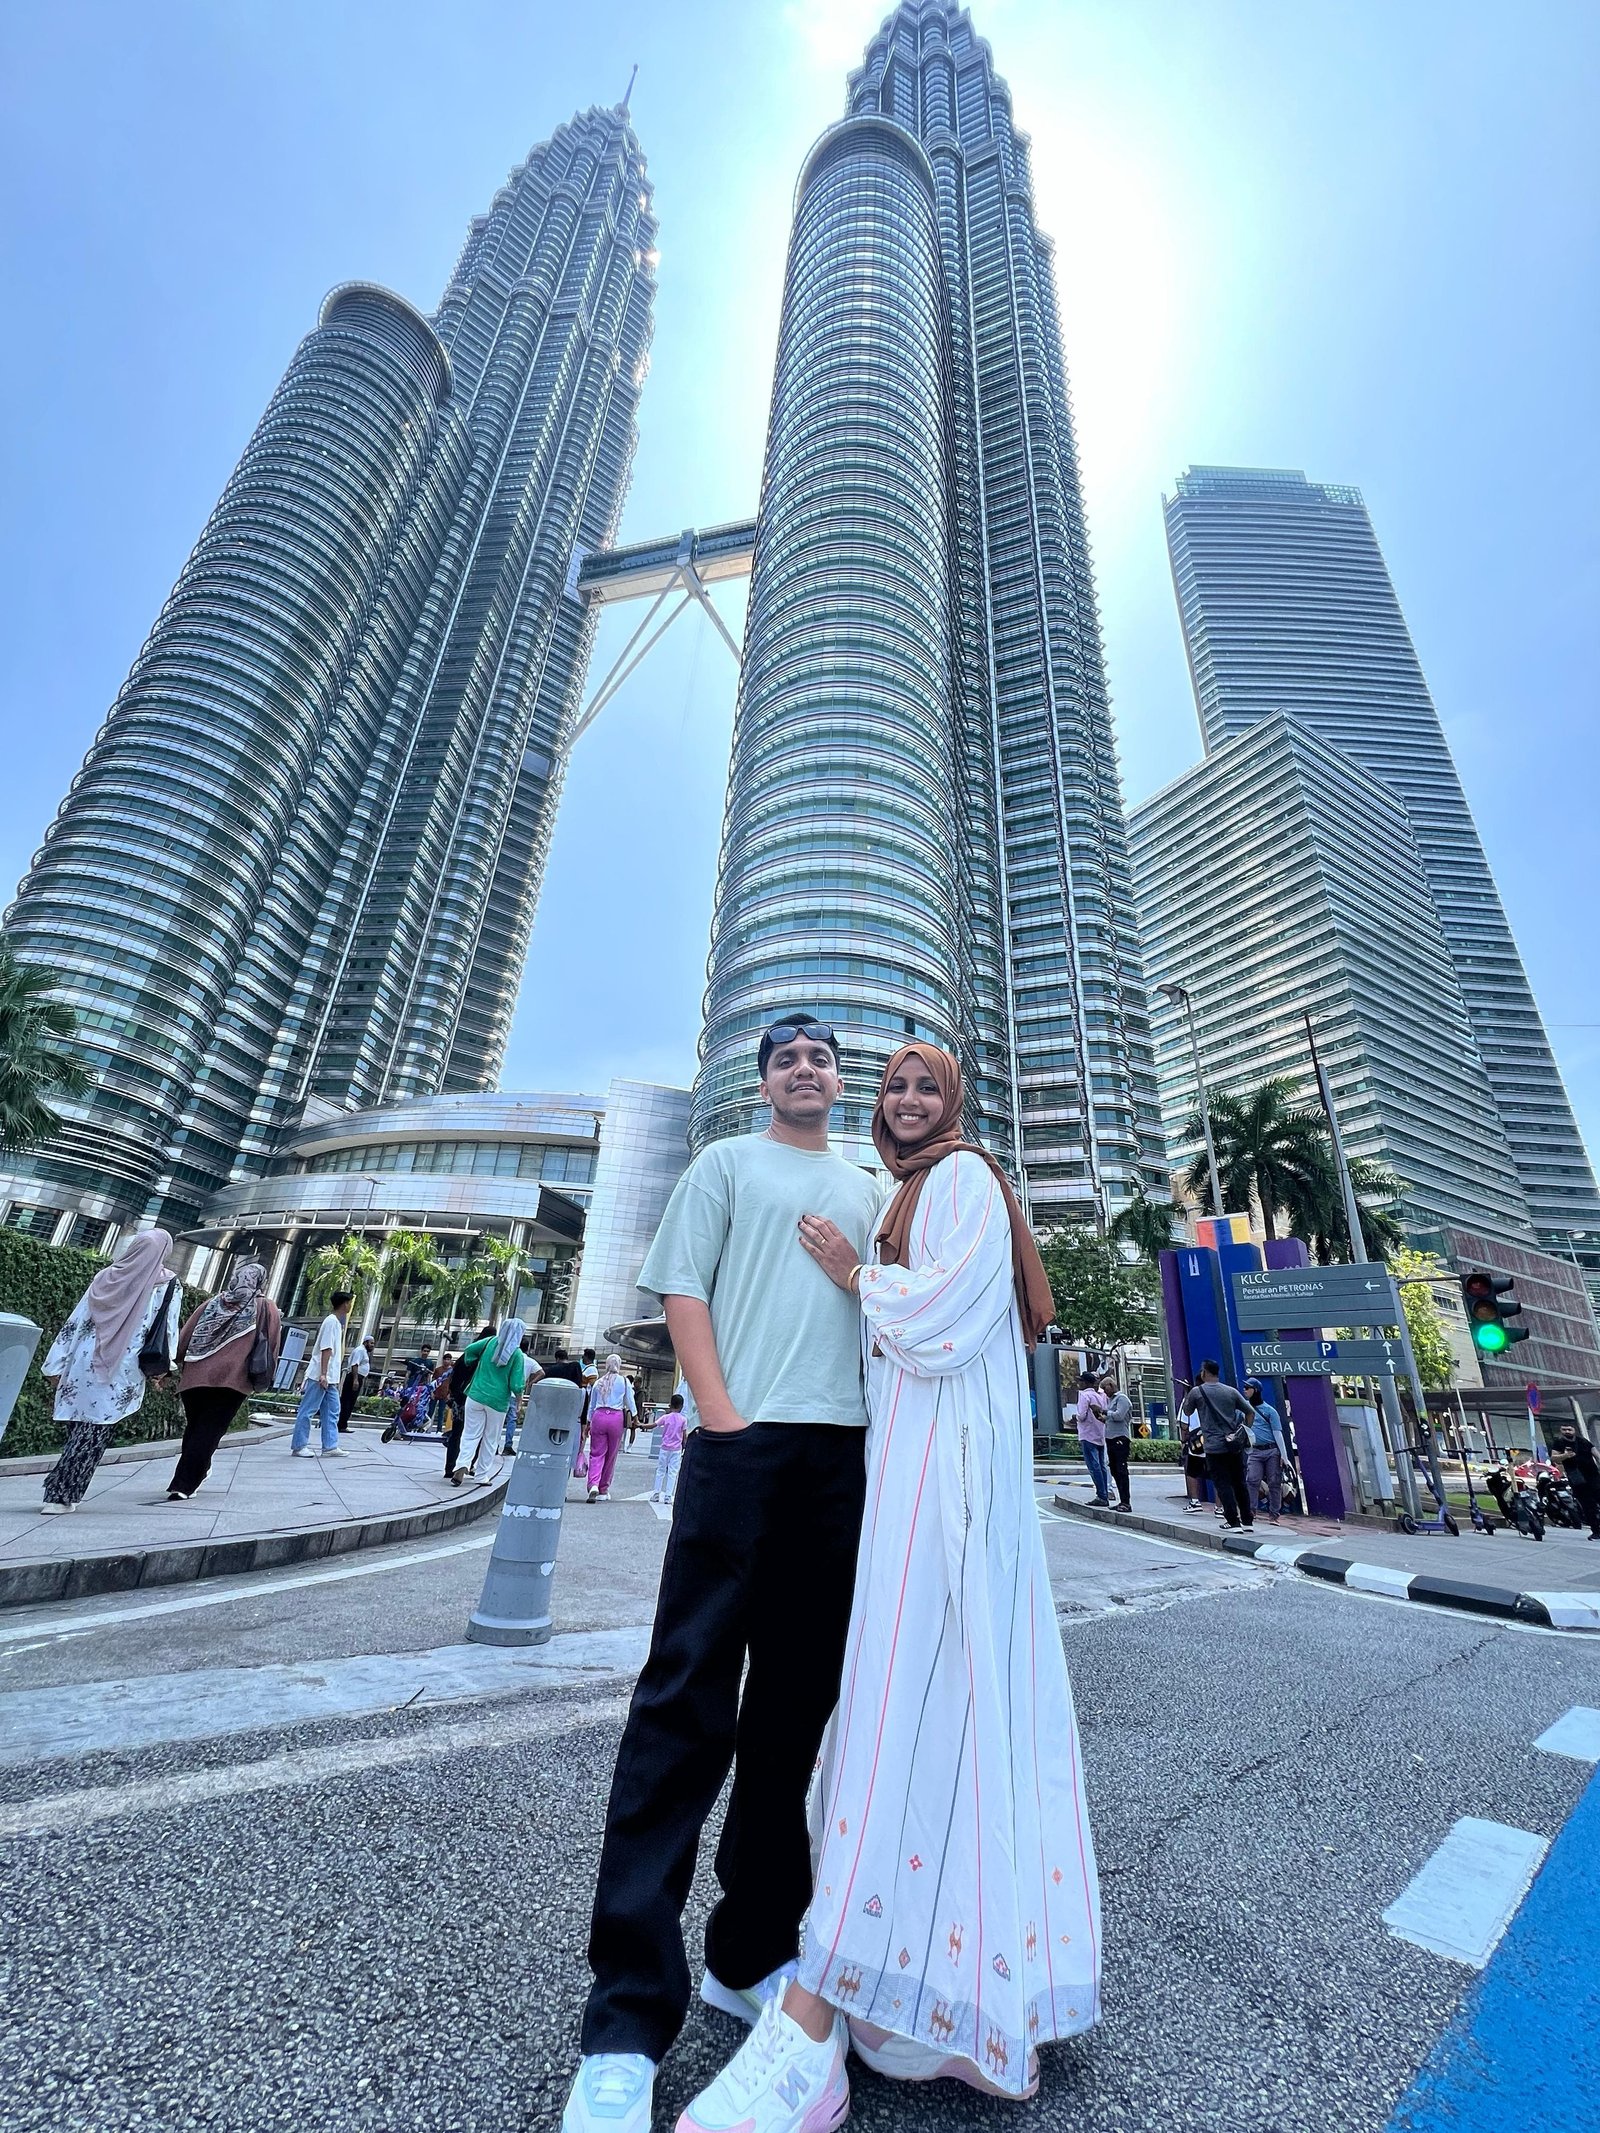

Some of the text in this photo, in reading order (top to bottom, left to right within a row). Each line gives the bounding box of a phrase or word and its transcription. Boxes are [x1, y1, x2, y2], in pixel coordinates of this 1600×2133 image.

[1240, 1273, 1271, 1285] KLCC
[1242, 1282, 1324, 1295] Persiaran PETRONAS
[1251, 1342, 1332, 1356] KLCC P
[1254, 1360, 1331, 1373] SURIA KLCC
